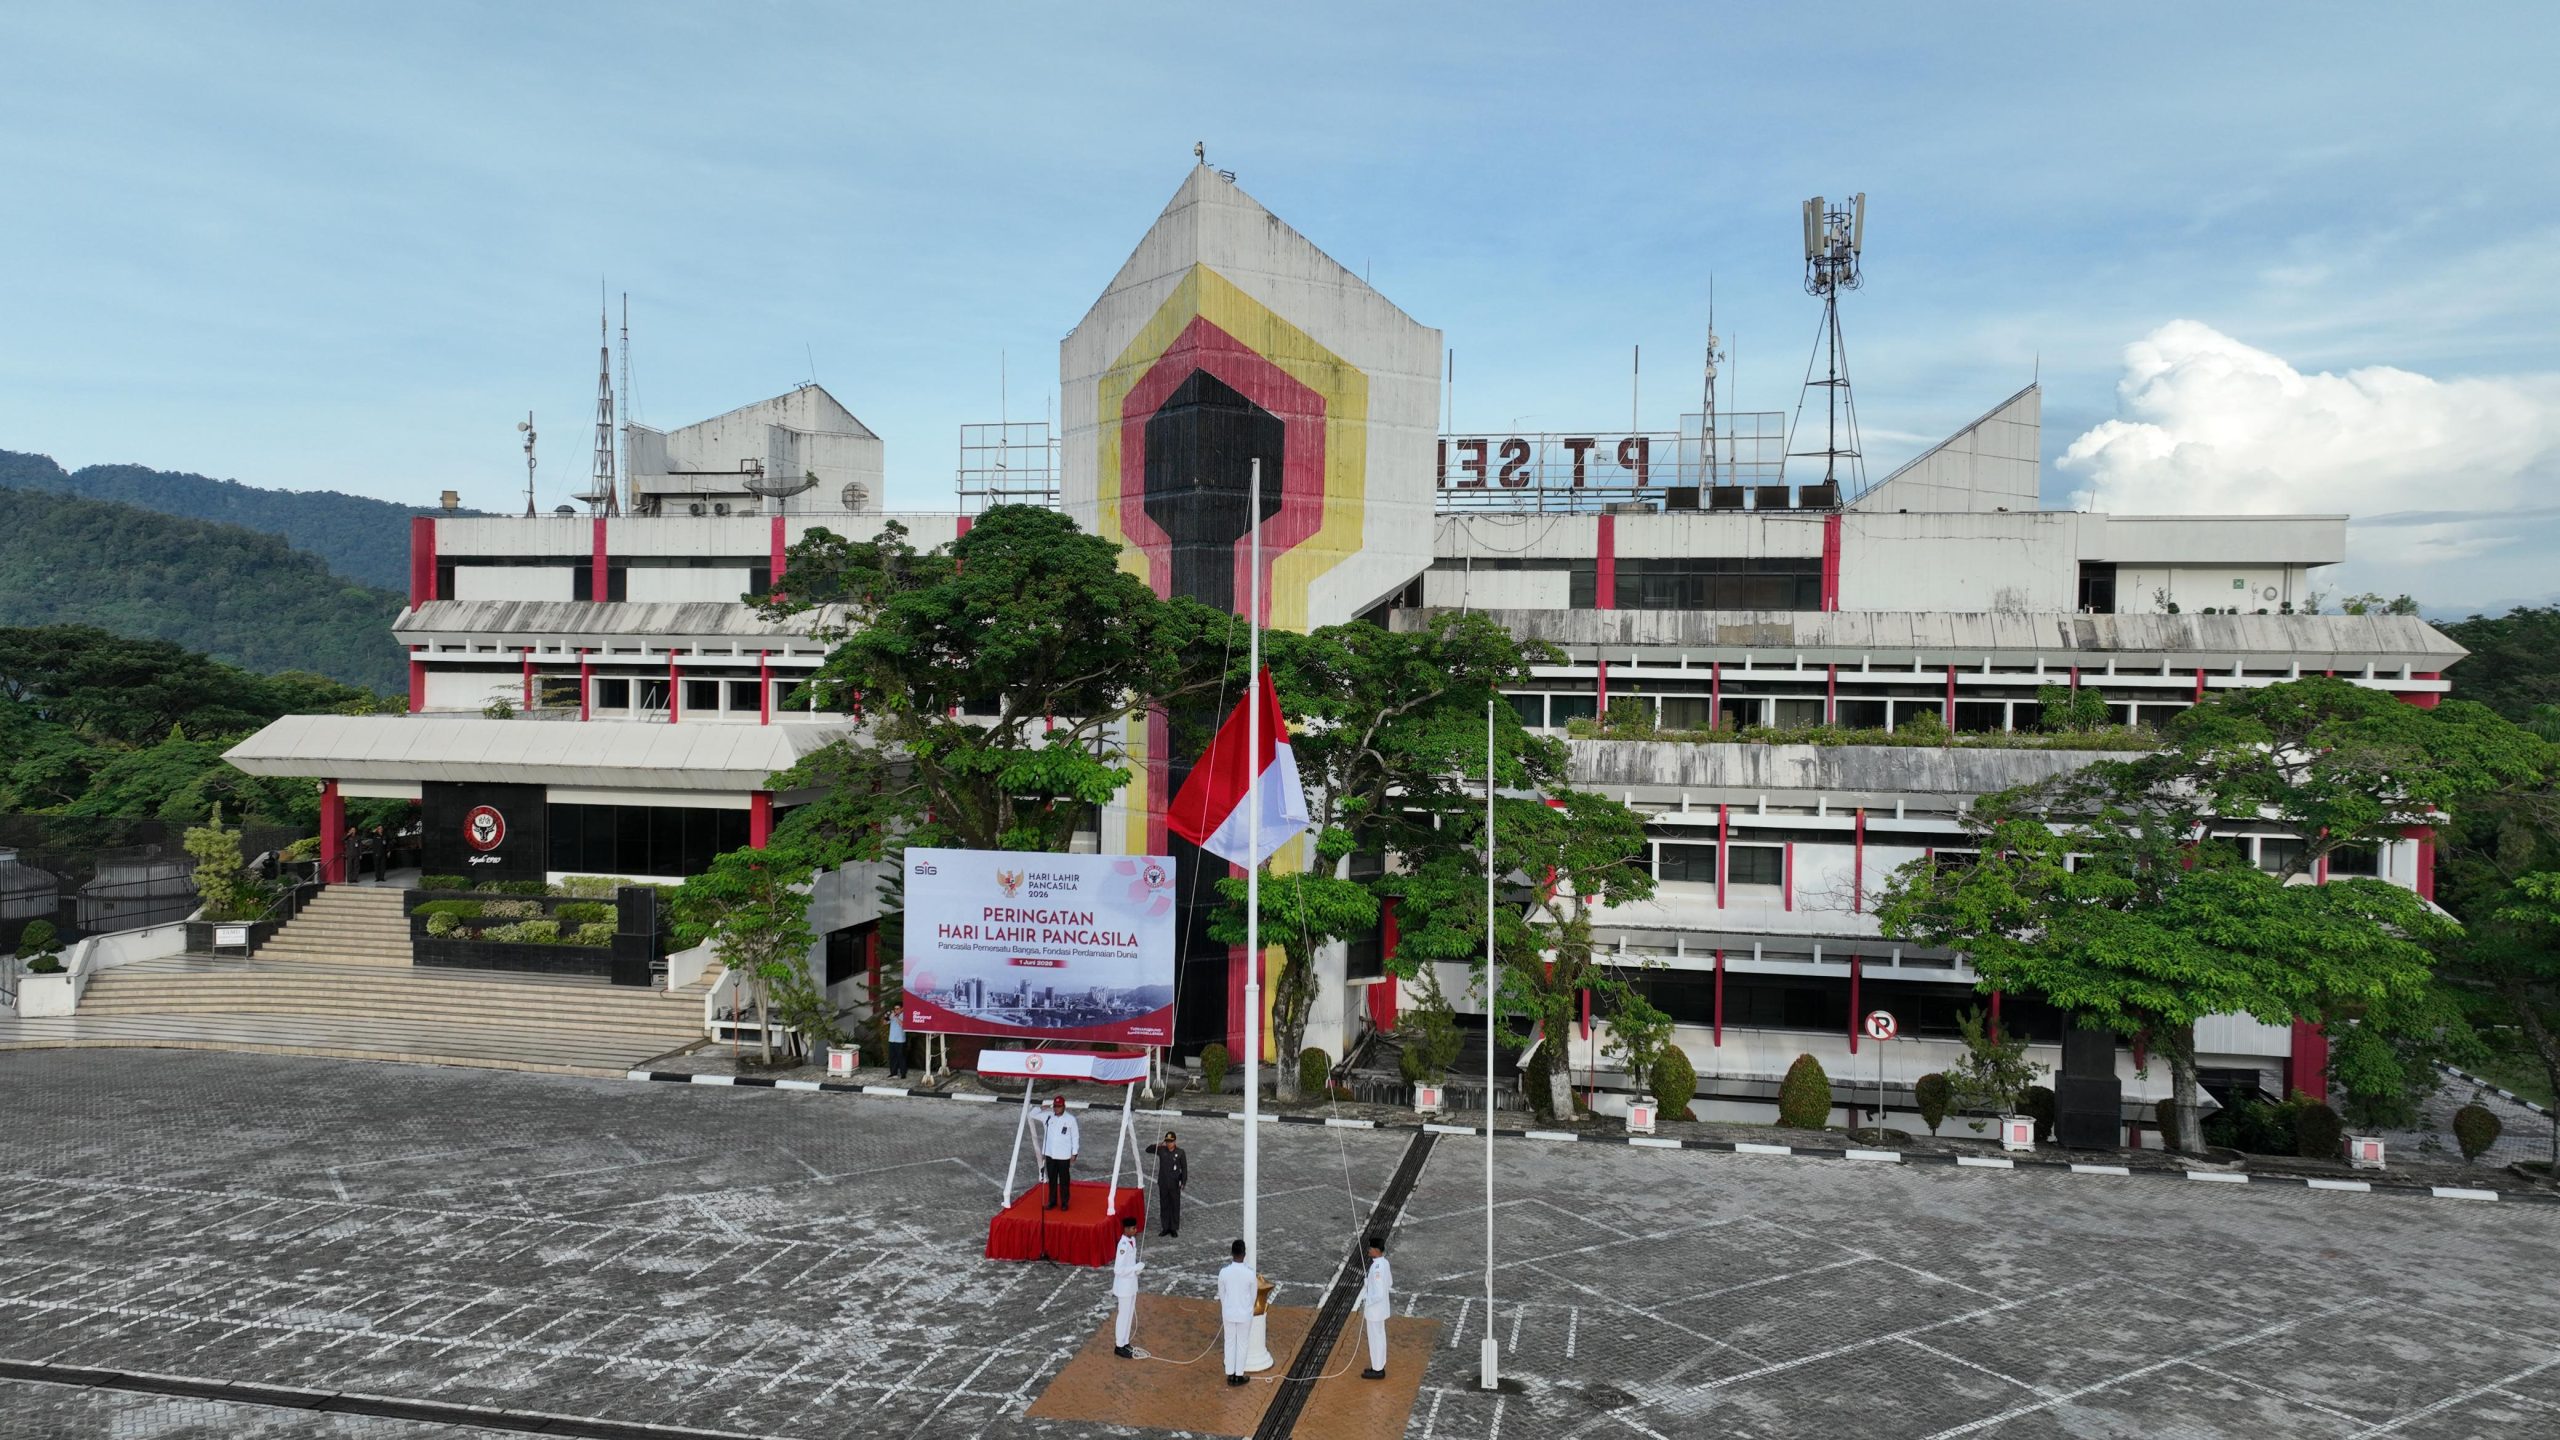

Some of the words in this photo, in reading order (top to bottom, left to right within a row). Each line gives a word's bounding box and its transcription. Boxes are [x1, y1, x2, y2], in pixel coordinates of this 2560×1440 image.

[914, 861, 937, 876] SIG
[1028, 873, 1050, 881] HARI
[1053, 873, 1080, 882] LAHIR
[1028, 882, 1078, 891] PANCASILA
[1028, 890, 1049, 898] 2026
[983, 907, 1094, 926] PERINGATAN
[938, 923, 979, 940] HARI
[985, 926, 1036, 943] LAHIR
[1043, 929, 1139, 947] PANCASILA
[938, 942, 972, 951] Pancasila
[973, 944, 1011, 953] Pemersatu
[1012, 946, 1041, 956] Bangsa,
[1042, 947, 1071, 955] Fondasi
[1072, 949, 1115, 958] Perdamaian
[1116, 951, 1138, 959] Dunia
[1875, 1016, 1890, 1035] P
